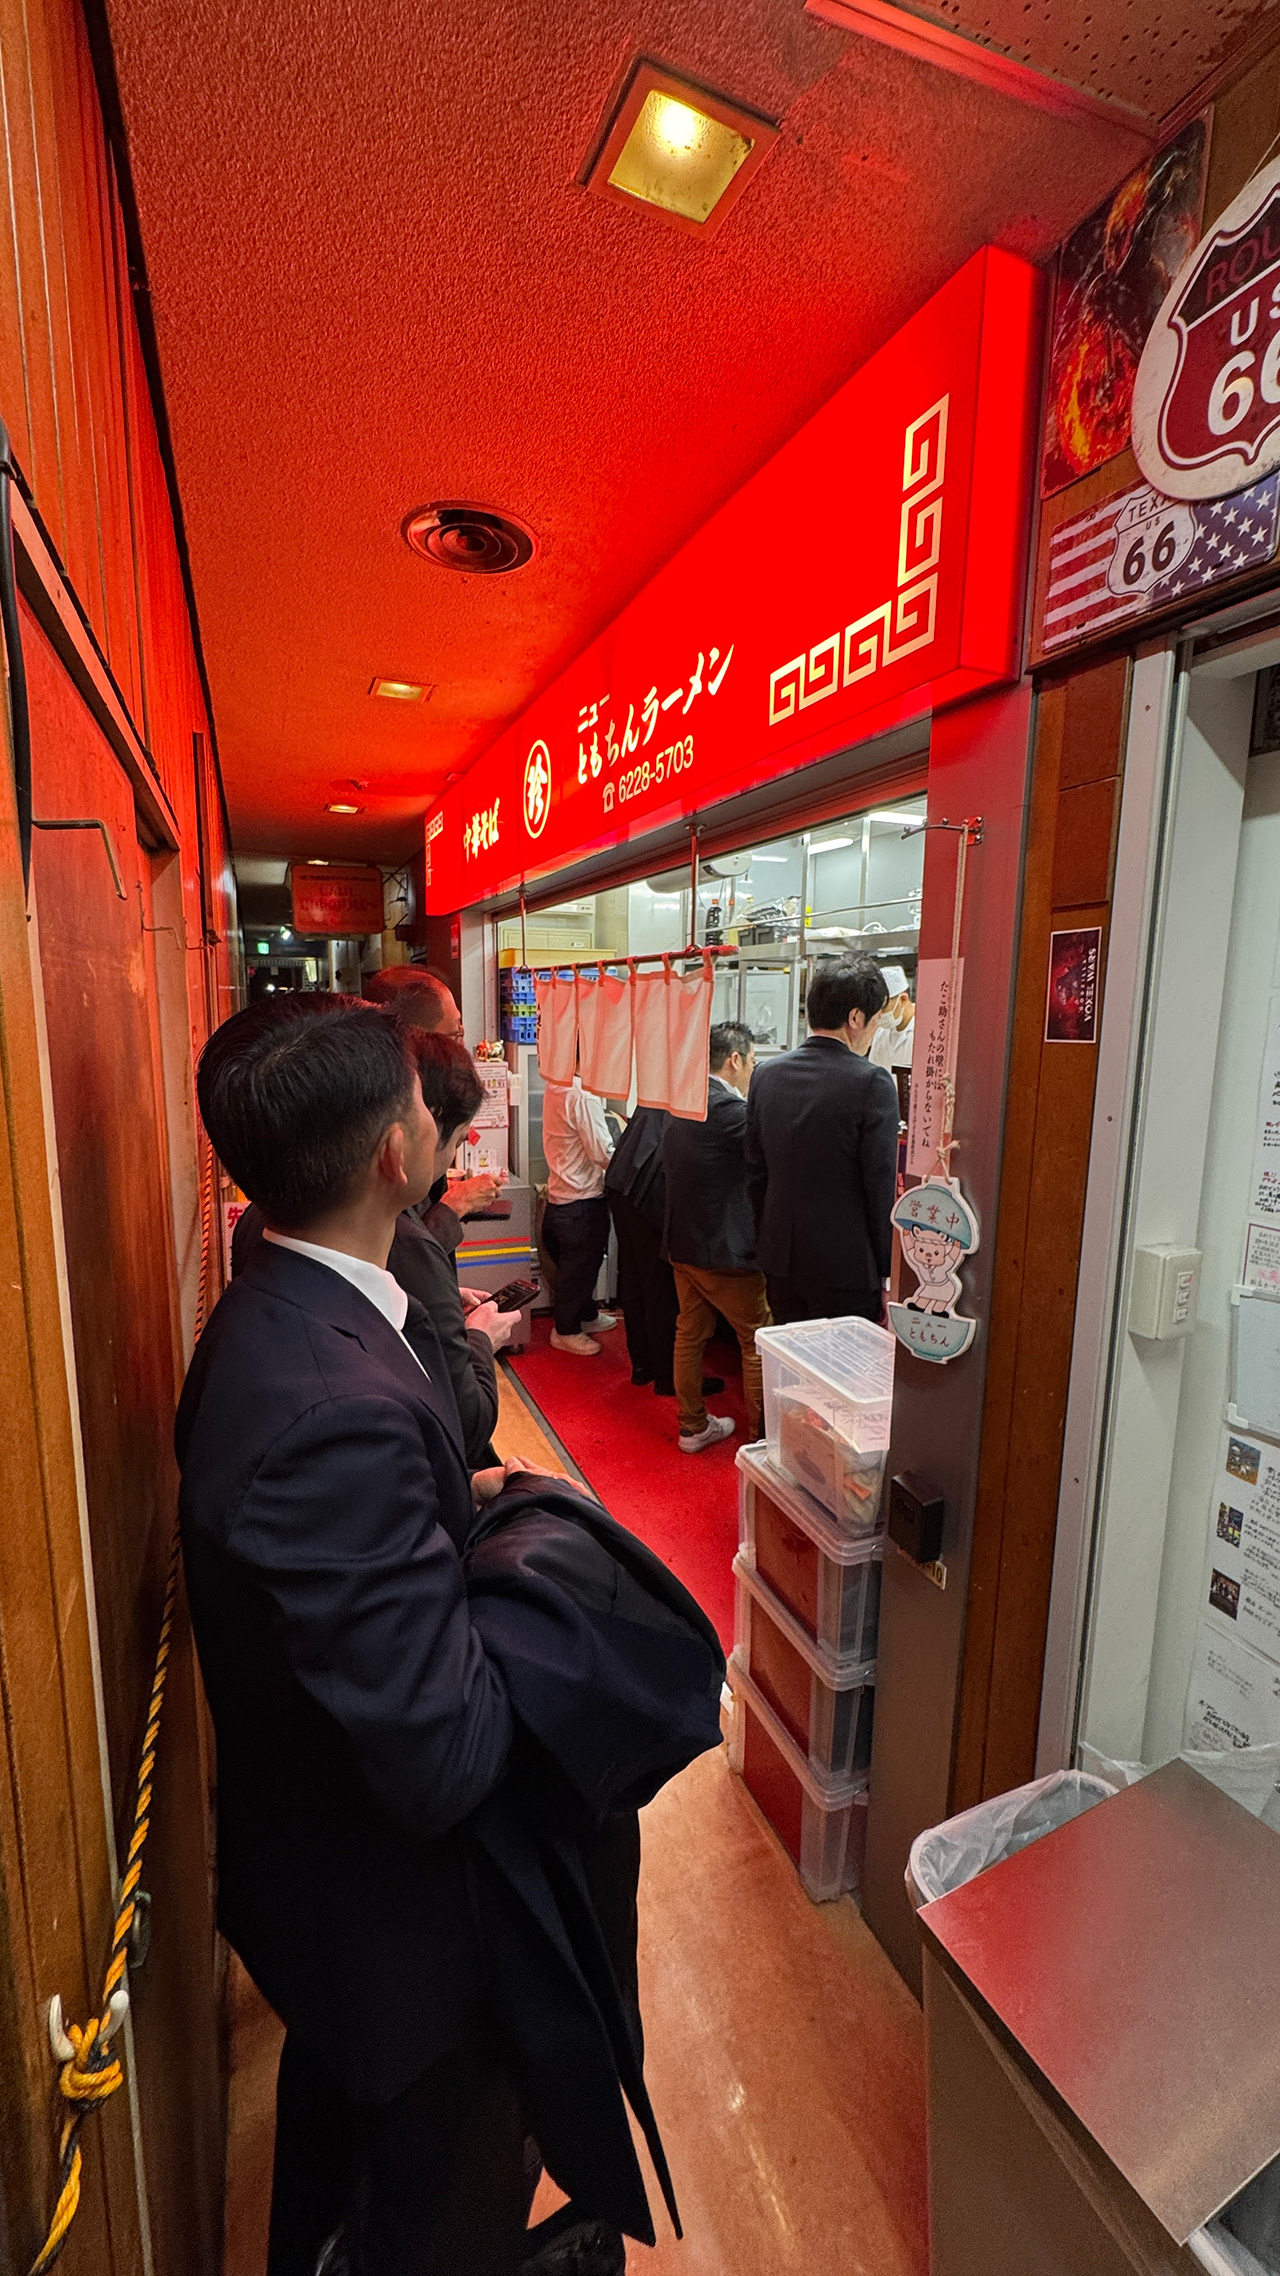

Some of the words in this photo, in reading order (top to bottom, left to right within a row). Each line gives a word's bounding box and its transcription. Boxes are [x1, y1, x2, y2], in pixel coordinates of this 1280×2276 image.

[1146, 516, 1160, 530] US
[1123, 521, 1176, 586] 66
[577, 693, 610, 734] ニュー
[577, 644, 734, 784] ともちんラーメン
[618, 734, 694, 804] 6228-5703
[463, 797, 500, 864] 中華そば
[1087, 948, 1097, 982] WARS
[1084, 983, 1094, 1022] VOXEL
[909, 1199, 960, 1228] 営業中
[909, 1327, 950, 1348] ともちん
[911, 1316, 947, 1329] ニュー
